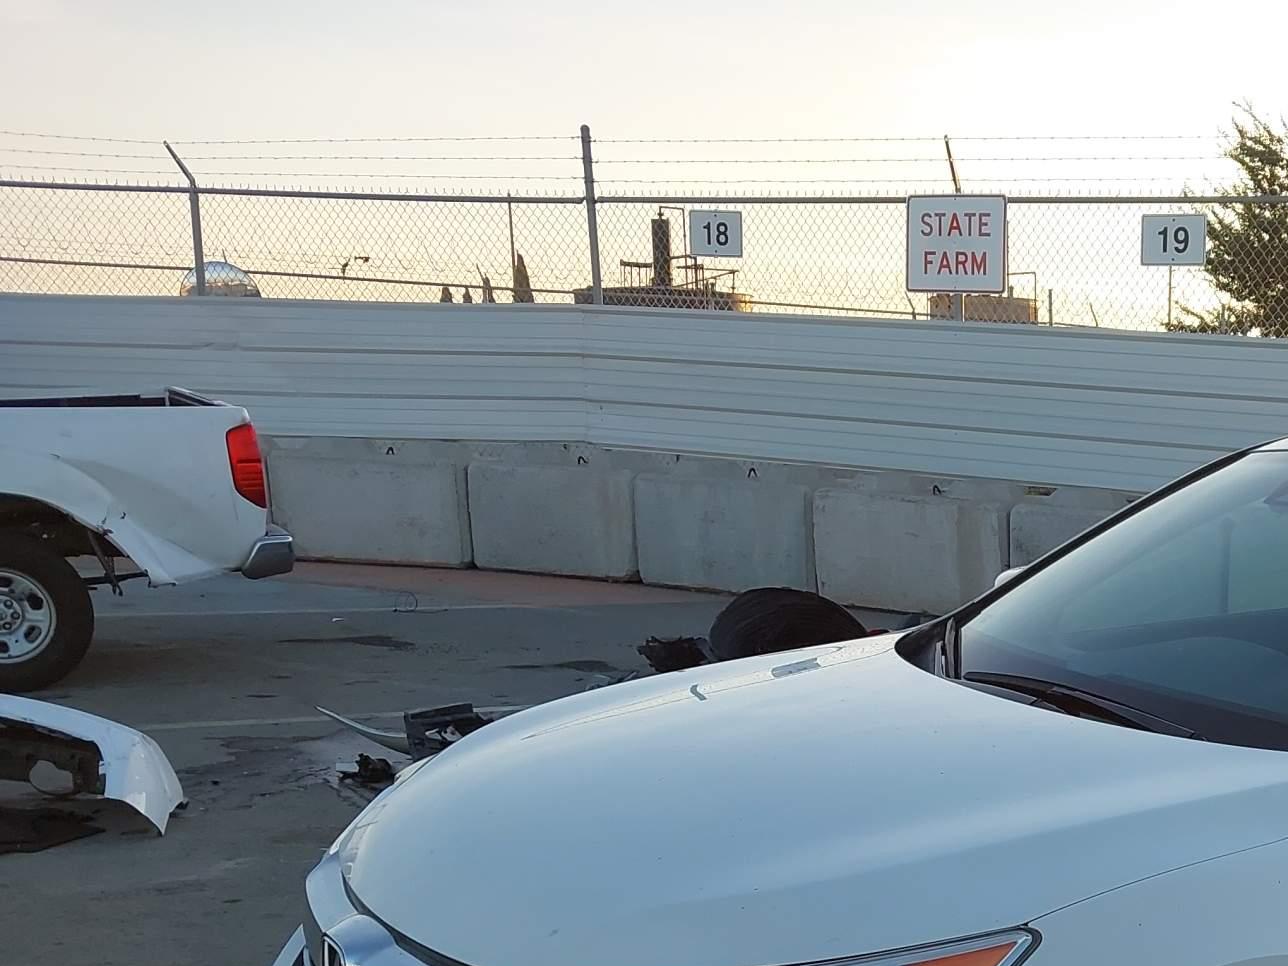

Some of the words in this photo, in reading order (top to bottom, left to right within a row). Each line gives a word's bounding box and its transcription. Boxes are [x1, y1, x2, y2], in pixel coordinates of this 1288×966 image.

[701, 221, 729, 247] 18
[920, 212, 992, 238] STATE
[1156, 226, 1190, 255] 19
[923, 250, 988, 276] FARM
